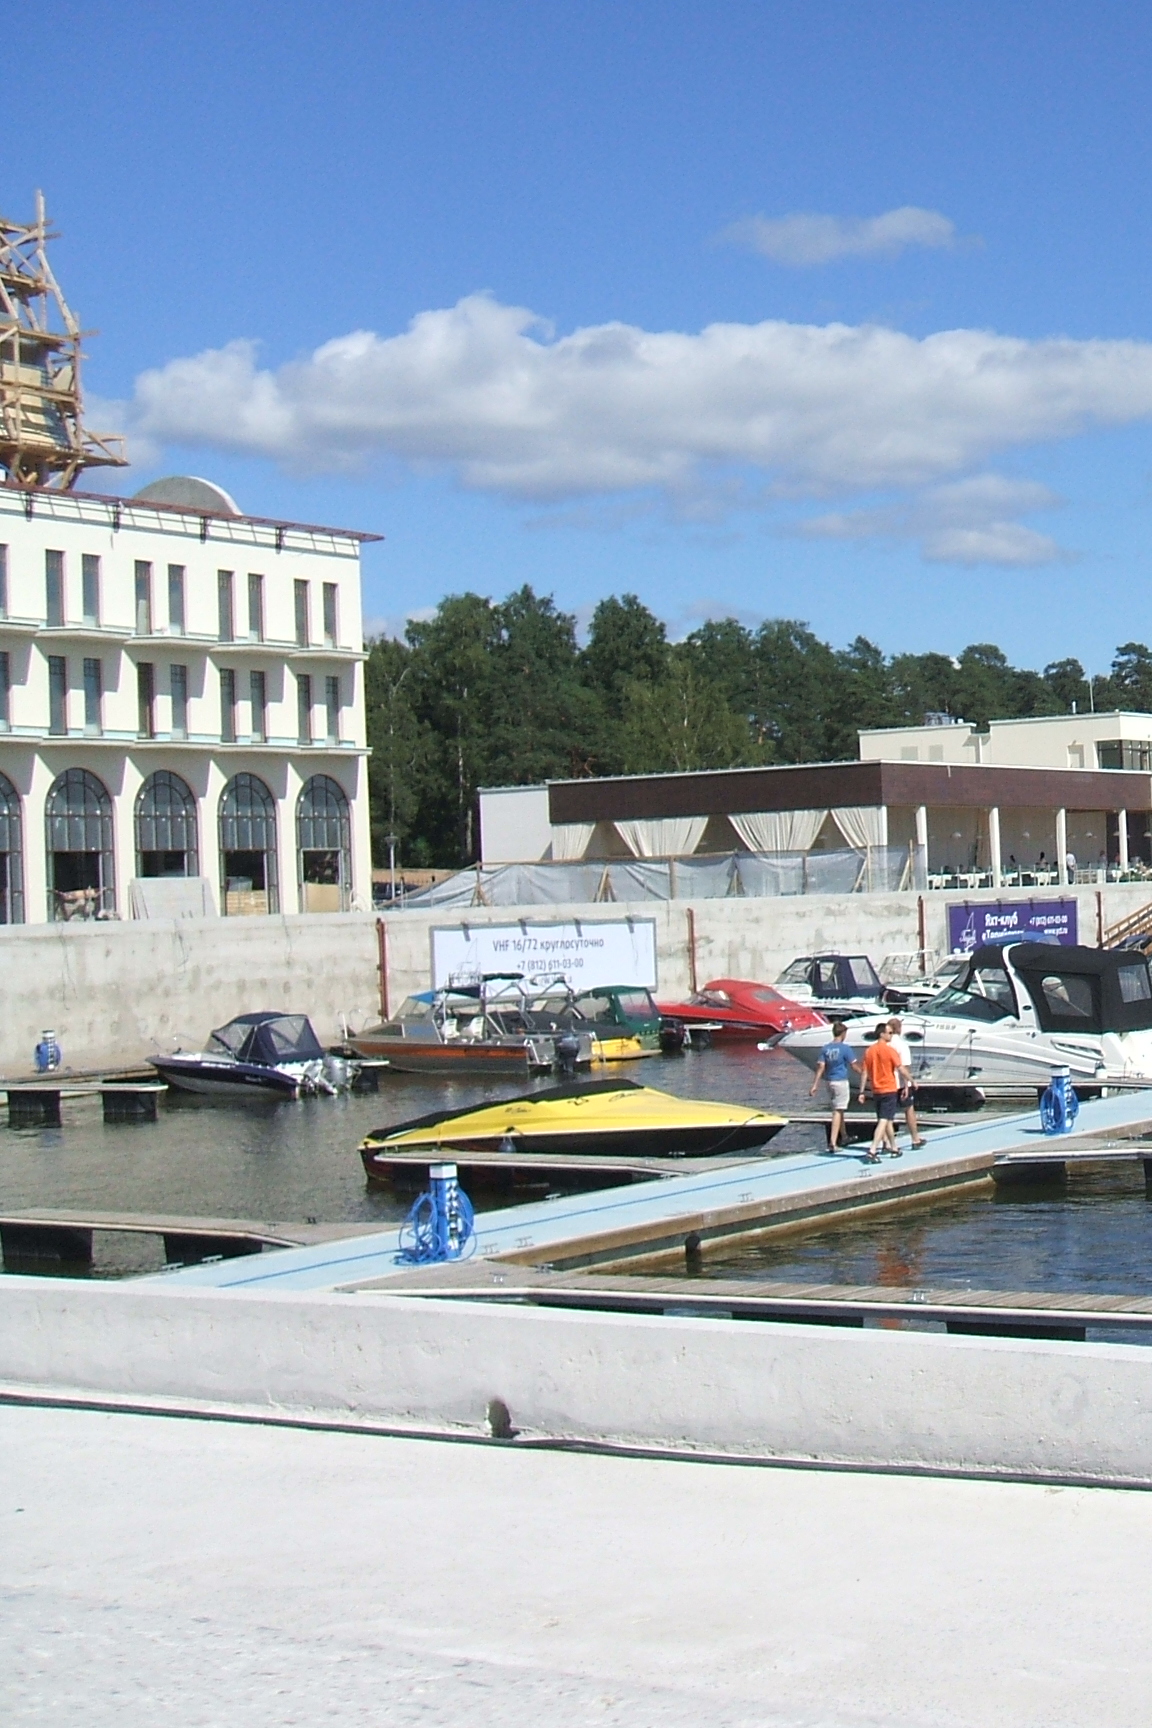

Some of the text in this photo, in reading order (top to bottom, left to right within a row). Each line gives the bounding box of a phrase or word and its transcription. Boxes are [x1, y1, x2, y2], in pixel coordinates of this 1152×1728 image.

[985, 911, 1018, 928] Яхт-клуб
[493, 938, 604, 952] VHF 16/72 круглосуточно
[517, 958, 584, 971] +7 (812) 611-03-00
